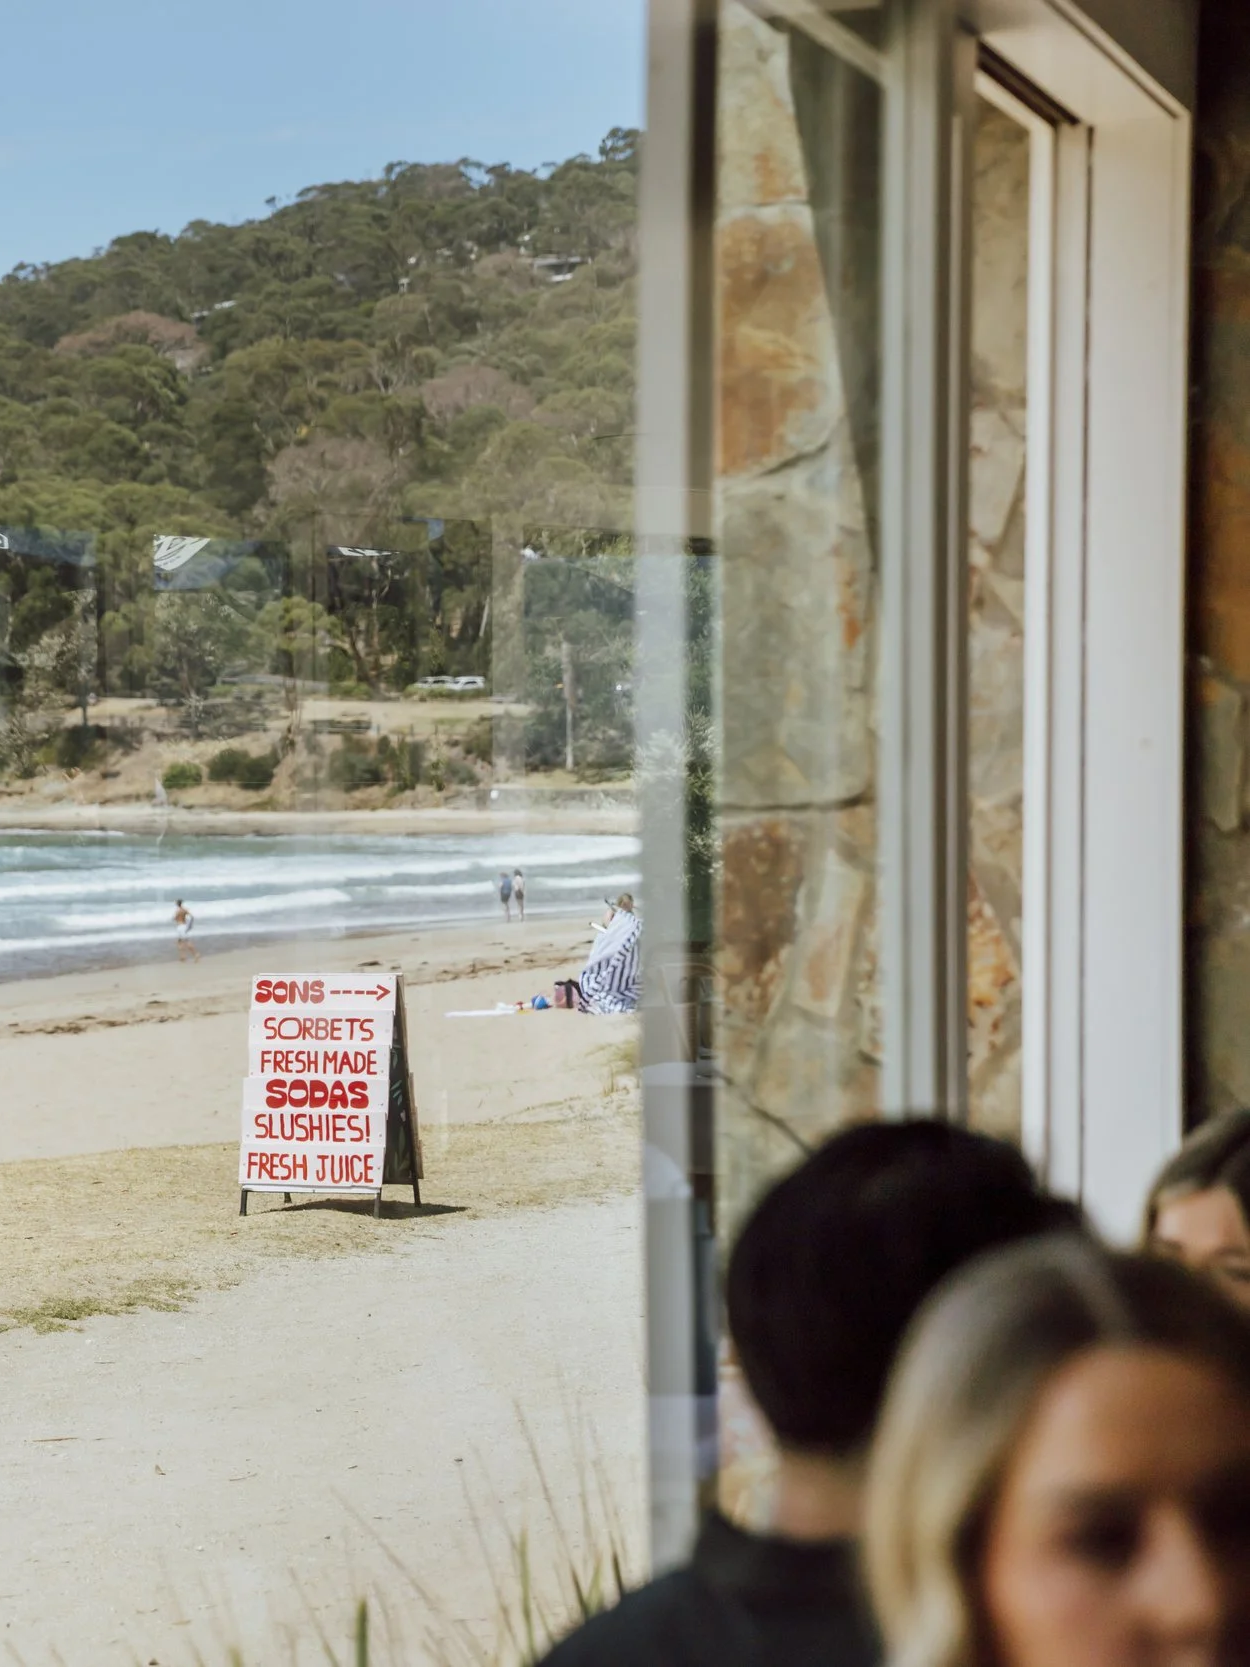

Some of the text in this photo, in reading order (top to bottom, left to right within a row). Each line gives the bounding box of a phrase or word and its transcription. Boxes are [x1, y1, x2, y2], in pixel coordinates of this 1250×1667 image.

[254, 979, 325, 1004] SONS
[263, 1016, 374, 1041] SORBETS
[260, 1050, 378, 1075] FRESH MADE
[265, 1078, 369, 1110] SODAS
[254, 1113, 371, 1143] SLUSHIES!
[247, 1152, 374, 1184] FRESH JUICE
